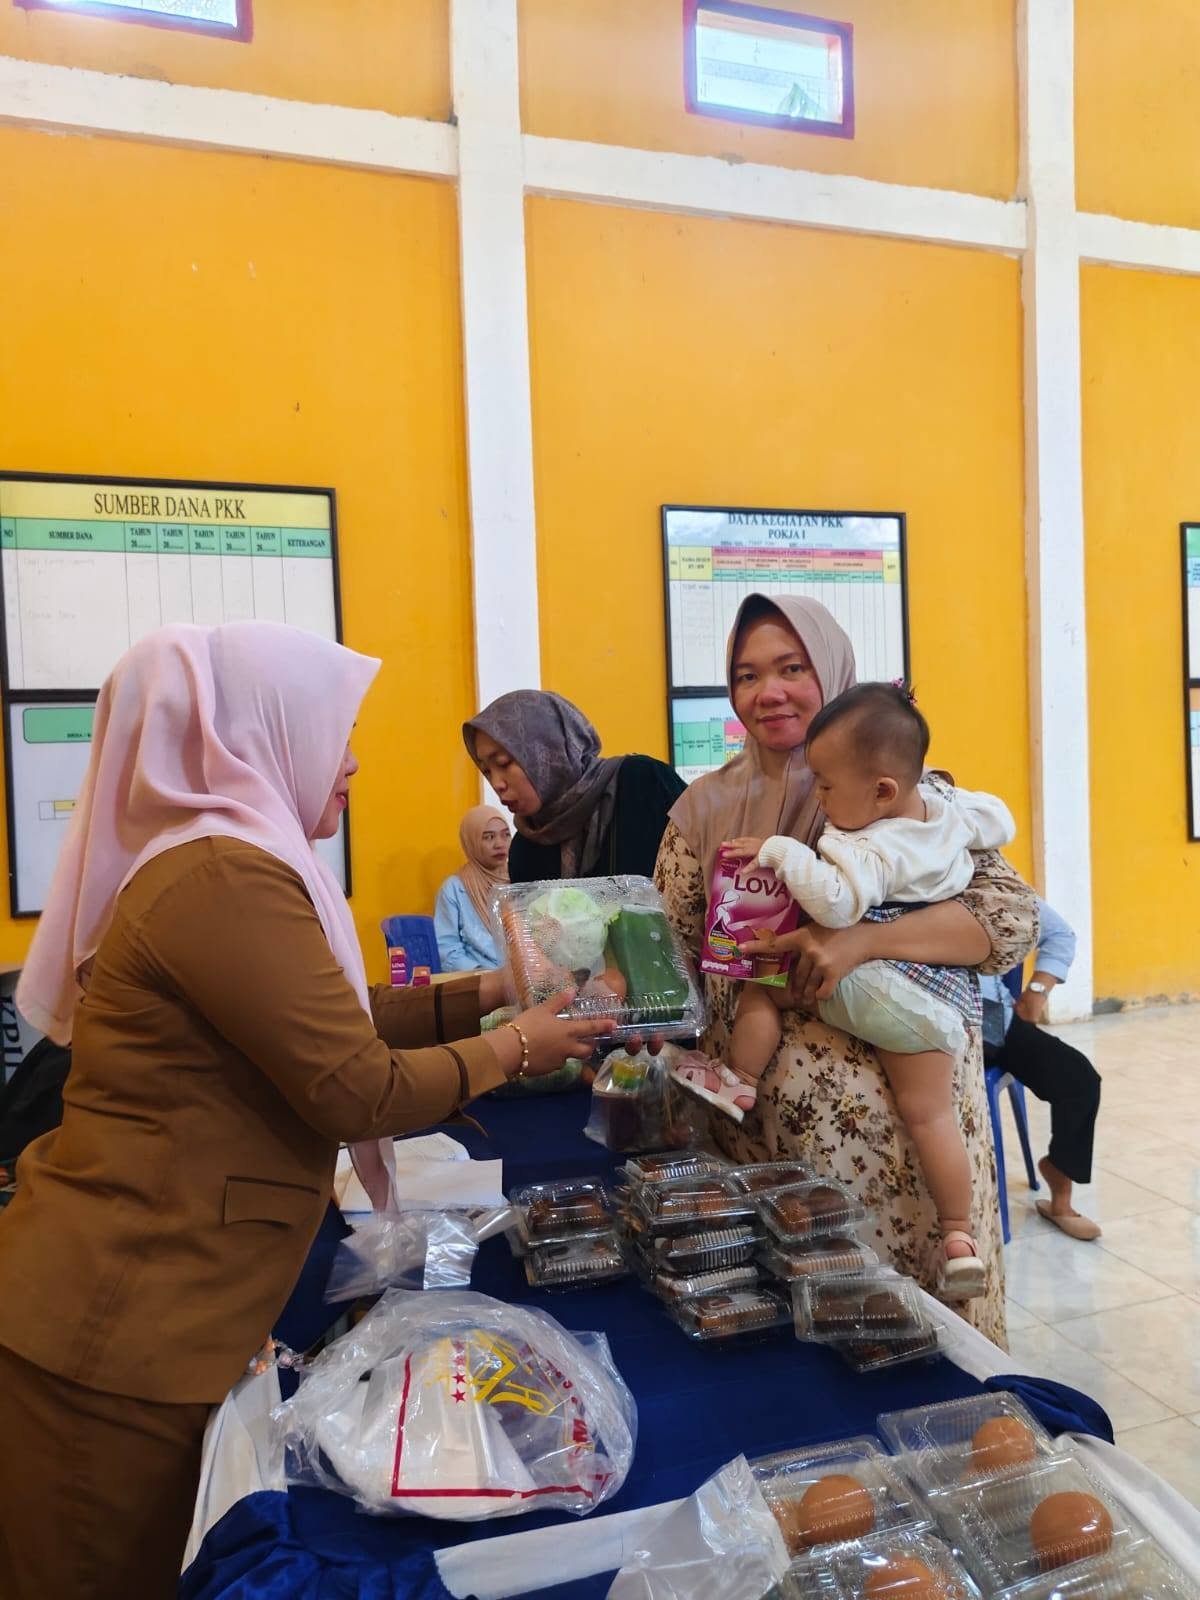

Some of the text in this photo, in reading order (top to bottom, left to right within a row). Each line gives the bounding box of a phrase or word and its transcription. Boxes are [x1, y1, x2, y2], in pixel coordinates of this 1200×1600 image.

[94, 493, 246, 519] SUMBER DANA PKK
[728, 513, 843, 528] DATA KEGIATAN PKK
[49, 531, 93, 541] SUMBER DANA
[130, 528, 151, 536] TAHUN
[162, 529, 183, 537] TAHUN
[194, 530, 214, 538] TAHUN
[225, 531, 245, 539] TAHUN
[256, 532, 276, 540] TAHUN
[768, 529, 800, 539] POKJA
[288, 539, 325, 548] KETERANGAN
